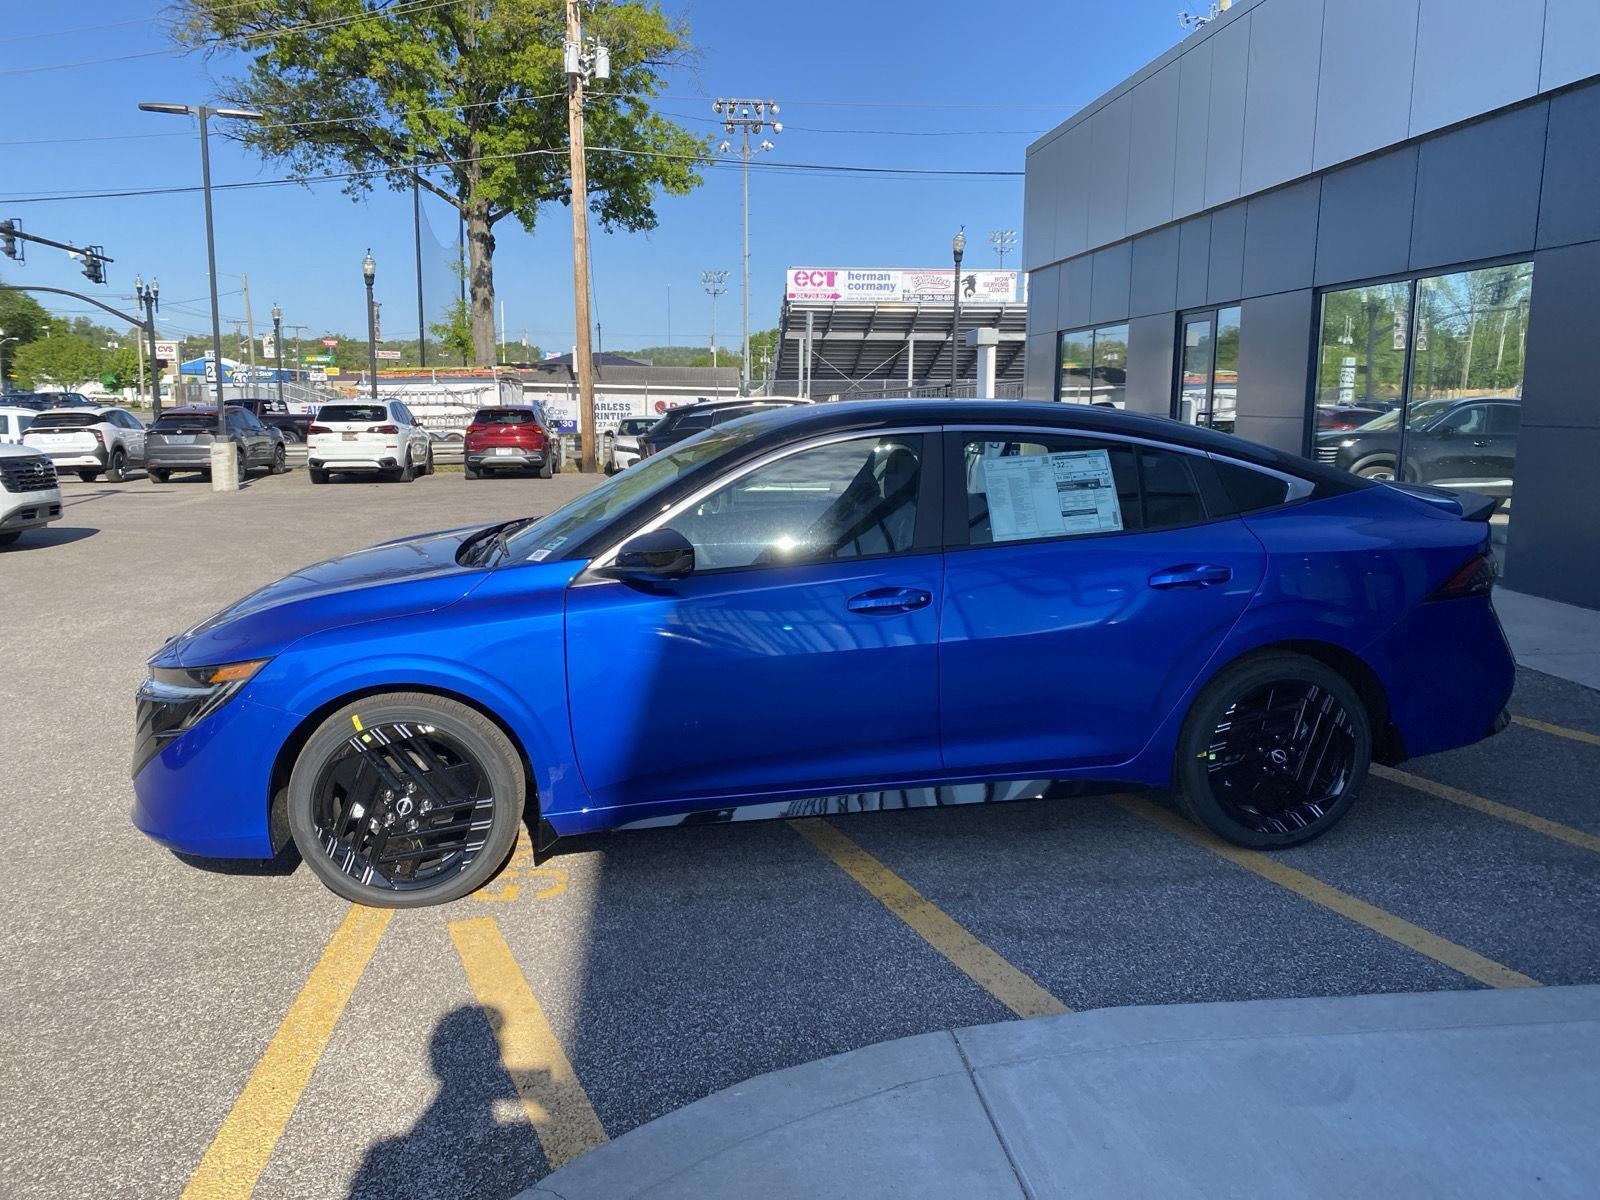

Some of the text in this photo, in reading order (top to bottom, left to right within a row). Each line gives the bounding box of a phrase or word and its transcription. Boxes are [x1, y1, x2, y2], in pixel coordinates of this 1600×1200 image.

[847, 271, 891, 281] herman
[847, 282, 896, 292] cormany
[234, 374, 248, 383] 60
